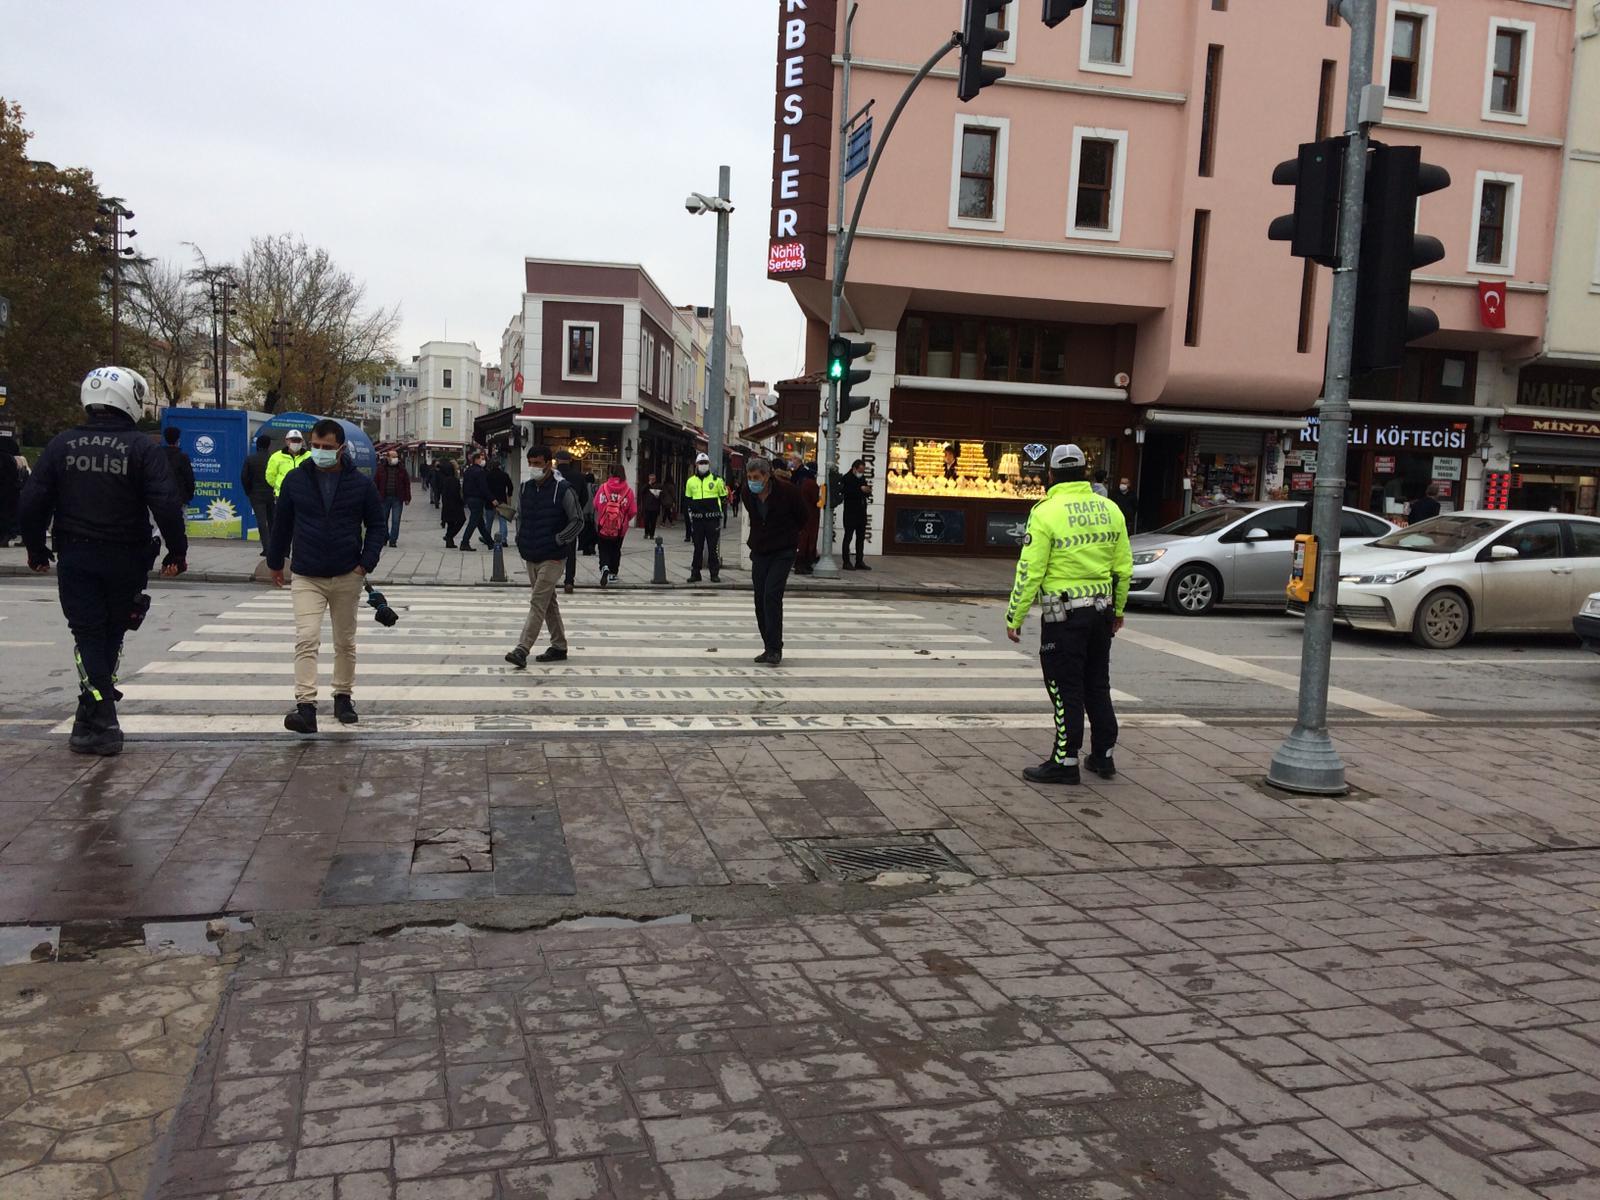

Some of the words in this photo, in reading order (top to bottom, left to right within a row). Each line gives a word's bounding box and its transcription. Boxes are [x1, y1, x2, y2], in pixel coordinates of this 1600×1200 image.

[771, 246, 801, 259] Nahit
[769, 257, 803, 270] Serbes
[84, 369, 120, 382] OLİS
[1376, 425, 1467, 449] KÖFTECİSİ
[66, 435, 129, 455] TRAFİK
[65, 454, 129, 476] POLİSİ
[924, 522, 934, 534] 8
[616, 667, 681, 676] EVE
[573, 716, 914, 729] #EVDEKAL
